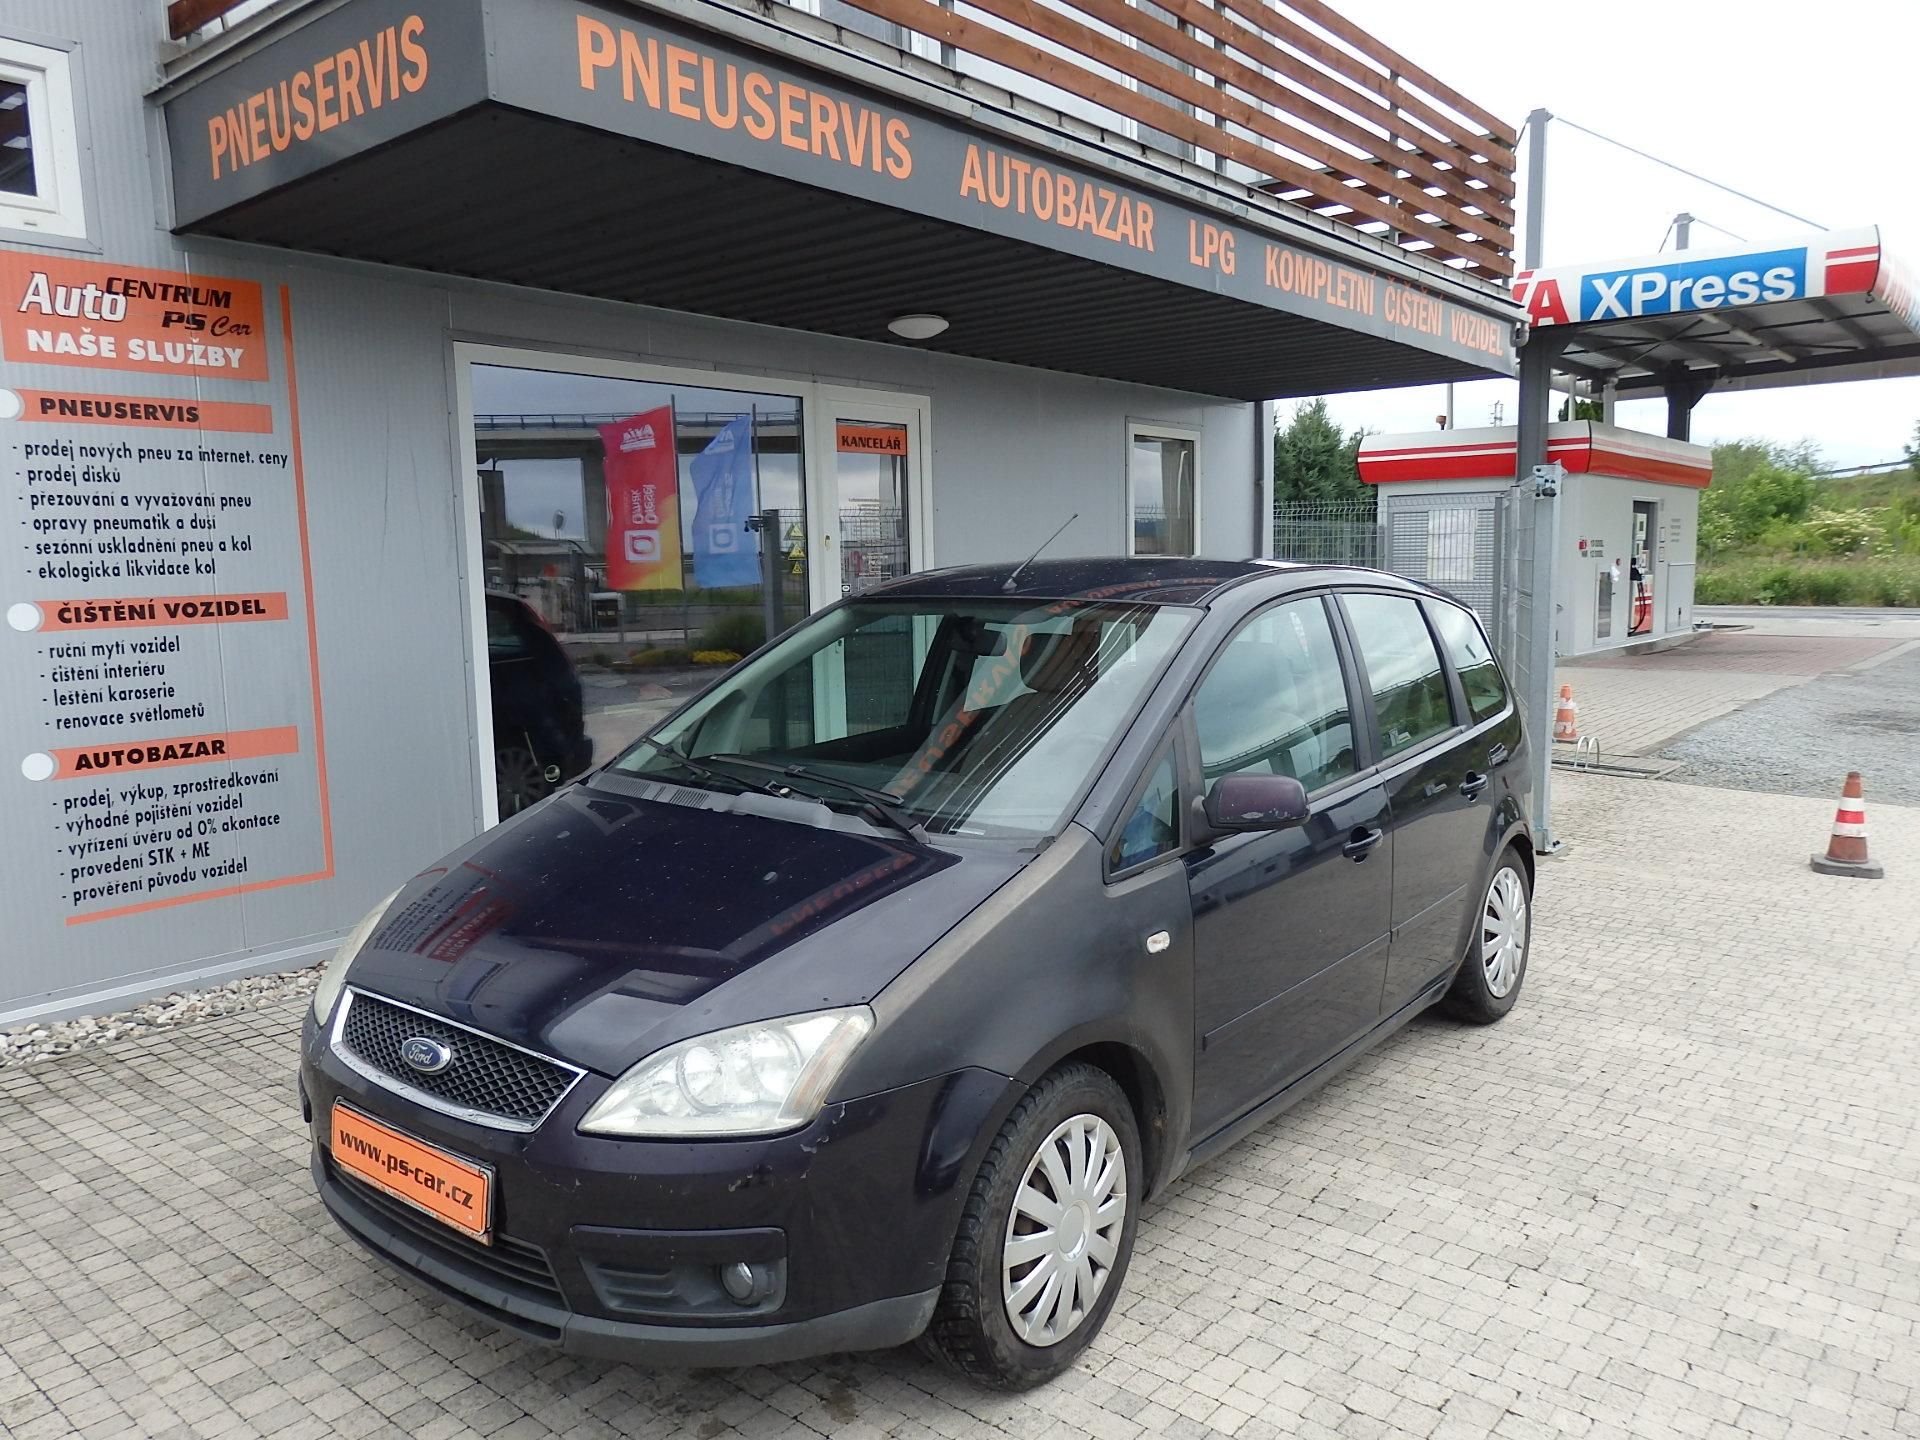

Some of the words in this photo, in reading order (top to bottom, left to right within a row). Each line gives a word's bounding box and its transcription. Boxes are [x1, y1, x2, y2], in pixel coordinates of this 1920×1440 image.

[208, 14, 428, 181] PNEUSERVIS
[576, 14, 913, 180] PNEUSERVIS
[960, 144, 1154, 251] AUTOBAZAR
[1189, 218, 1236, 276] LPG
[1264, 244, 1377, 316] KOMPLETNÍ
[1451, 308, 1503, 356] VOZIDEL
[17, 271, 128, 323] Auto
[106, 276, 232, 308] CENTRUM
[1590, 266, 1796, 321] XPress
[161, 311, 207, 331] PS
[210, 315, 252, 337] Car
[26, 326, 116, 358] NAŠE
[128, 338, 245, 369] SLUŽBY
[40, 397, 200, 423] PNEUSERVIS
[25, 439, 74, 461] prodej
[80, 442, 132, 463] nových
[138, 448, 172, 463] pneu
[177, 449, 193, 461] za
[198, 445, 254, 463] internet.
[259, 452, 288, 469] ceny
[841, 435, 901, 450] KANCELÁŘ
[27, 464, 77, 486] prodej
[82, 464, 121, 482] disků
[31, 491, 115, 510] přezouvání
[121, 495, 129, 506] a
[135, 491, 216, 511] vyvažování
[220, 496, 252, 511] pneu
[33, 518, 87, 534] opravy
[94, 513, 170, 534] pneumatik
[176, 518, 184, 529] a
[36, 538, 92, 554] sezónní
[98, 536, 176, 553] uskladnění
[181, 541, 213, 556] pneu
[219, 541, 226, 551] a
[231, 535, 251, 551] kol
[39, 560, 121, 582] ekologická
[126, 558, 190, 576] likvidace
[195, 558, 215, 574] kol
[58, 598, 156, 624] ČIŠTĚNÍ
[164, 599, 266, 619] VOZIDEL
[49, 641, 86, 658] ruční
[92, 640, 125, 660] mytí
[130, 635, 181, 654] vozidel
[52, 664, 99, 682] čištění
[104, 660, 165, 678] interiéru
[54, 687, 103, 706] leštění
[109, 682, 175, 702] karoserie
[56, 713, 124, 729] renovace
[130, 702, 205, 724] světlometů
[75, 739, 226, 770] AUTOBAZAR
[64, 788, 114, 814] prodej,
[120, 783, 167, 805] výkup,
[173, 768, 279, 798] zprostředkování
[66, 810, 130, 836] výhodné
[136, 801, 191, 827] pojištění
[197, 793, 243, 814] vozidel
[69, 833, 128, 859] vyřízení
[133, 829, 172, 846] úvěru
[177, 821, 192, 839] od
[198, 818, 217, 836] 0%
[222, 814, 280, 832] akontace
[71, 853, 143, 883] provedení
[148, 847, 175, 866] STK
[193, 841, 210, 859] ME
[73, 876, 143, 906] prověření
[148, 866, 196, 892] původu
[202, 856, 247, 878] vozidel
[407, 1042, 434, 1065] Ford
[339, 1129, 474, 1210] www.ps-car.cz
